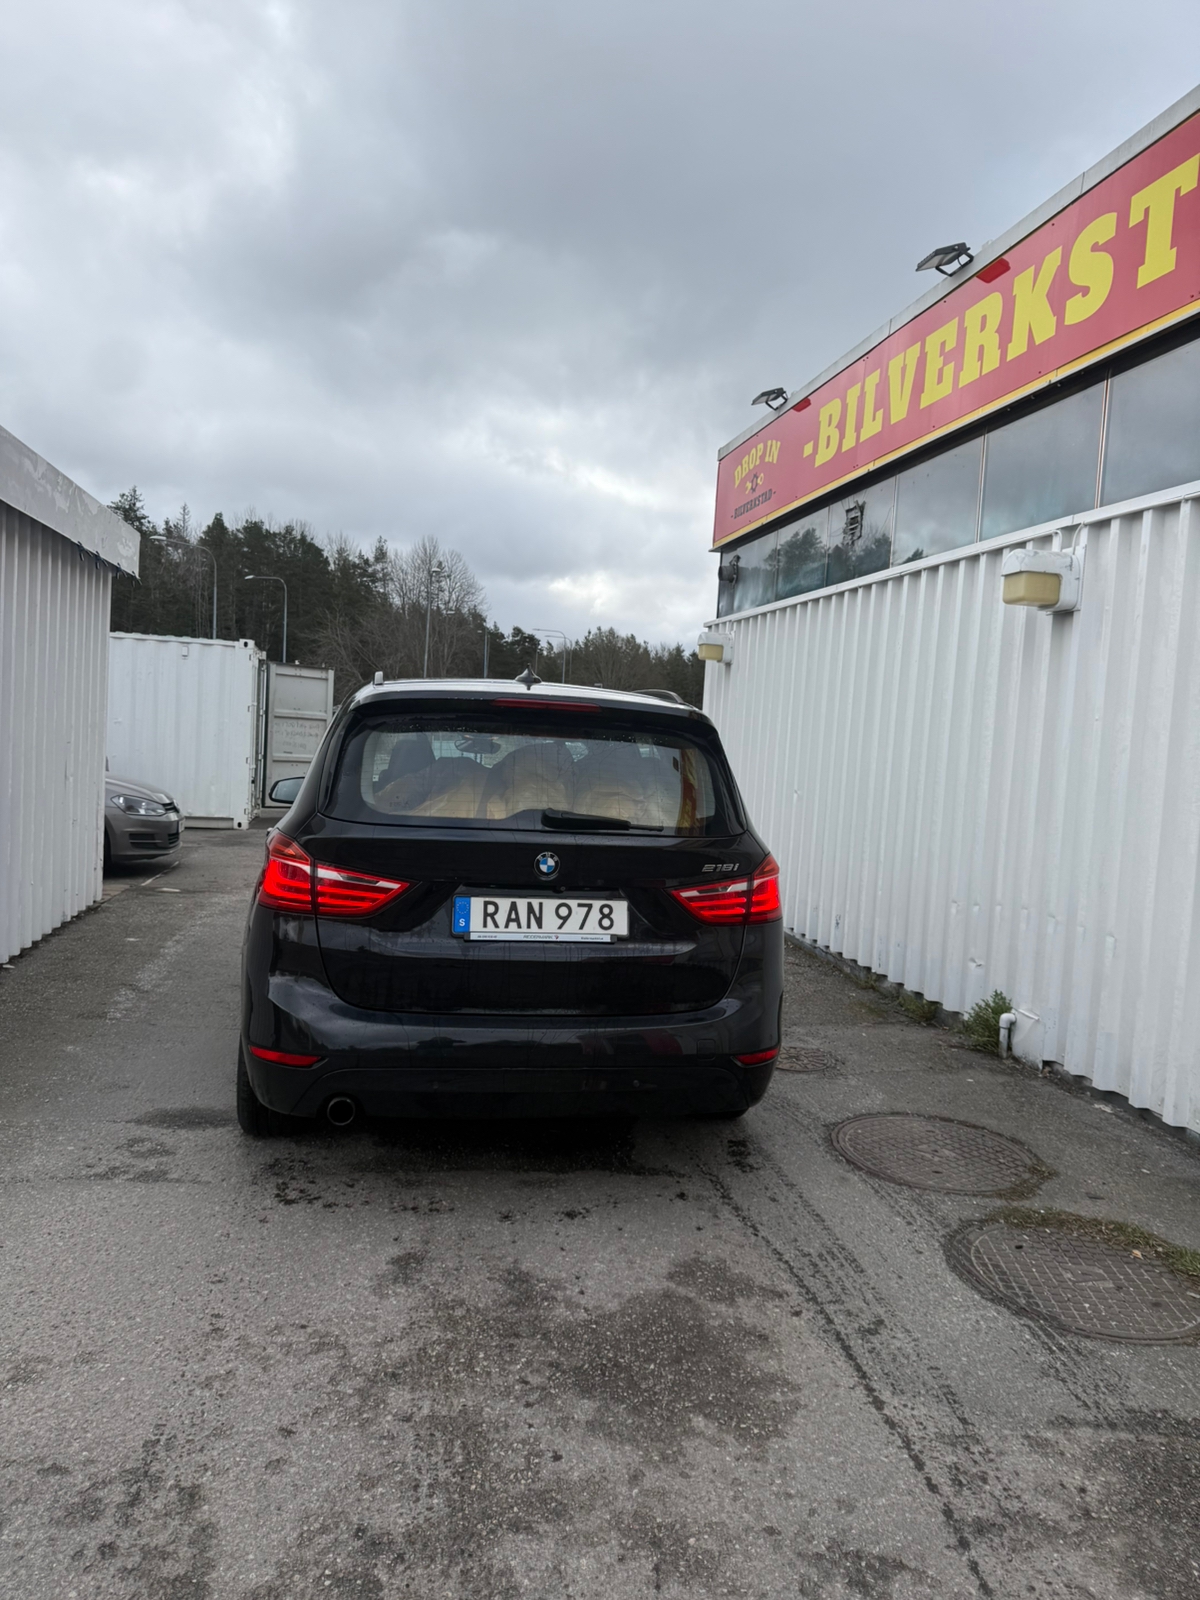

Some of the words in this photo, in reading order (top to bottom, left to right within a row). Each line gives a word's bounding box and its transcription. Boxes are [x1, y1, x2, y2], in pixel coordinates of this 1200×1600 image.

[734, 442, 764, 489] DROP
[764, 439, 781, 465] IN
[459, 918, 466, 927] S
[482, 900, 544, 930] RAN
[554, 902, 615, 931] 978
